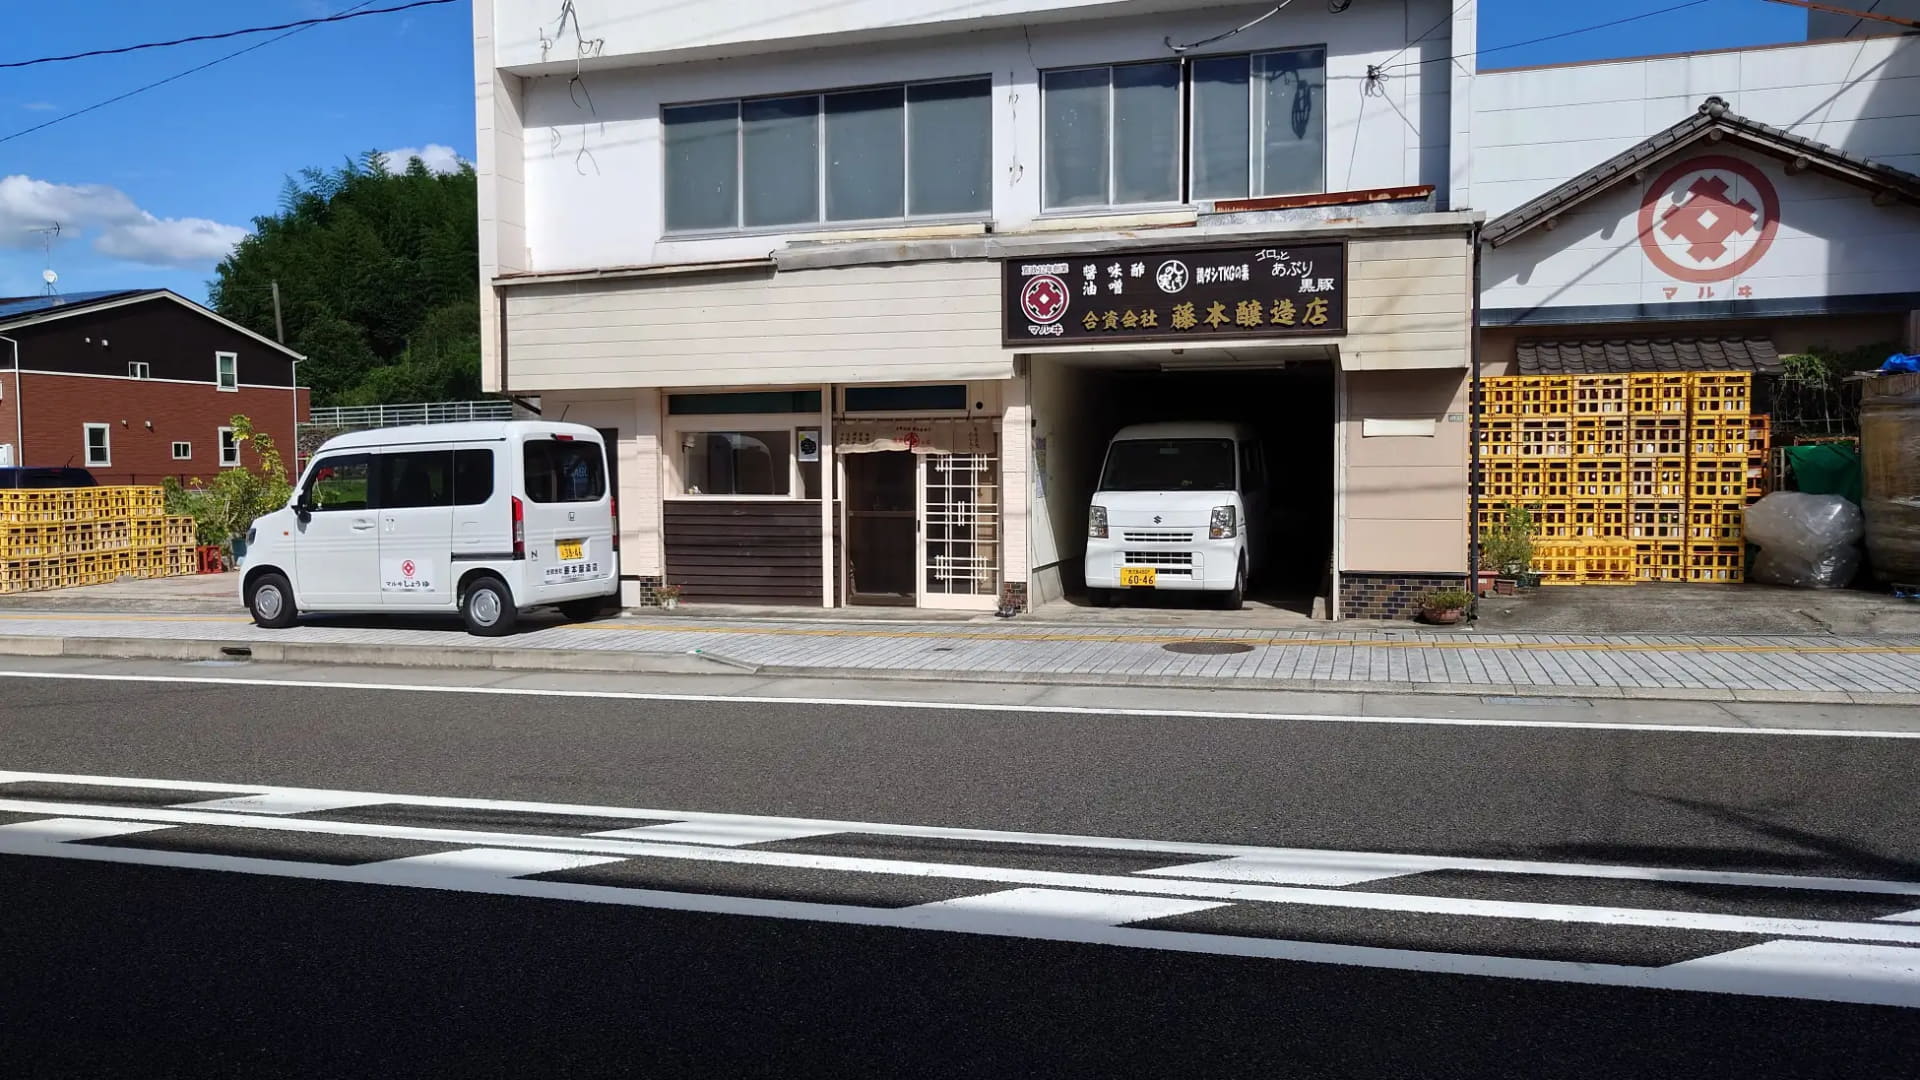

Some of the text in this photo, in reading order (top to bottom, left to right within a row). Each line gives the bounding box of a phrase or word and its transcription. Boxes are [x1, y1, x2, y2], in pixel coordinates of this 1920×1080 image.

[1107, 262, 1123, 295] 味噌
[1130, 261, 1145, 278] 酢
[1271, 261, 1313, 279] あぶり
[1082, 263, 1098, 296] 醤油
[1298, 278, 1335, 293] 黒豚
[1081, 308, 1159, 330] 合資会社
[1128, 576, 1154, 584] 60-46
